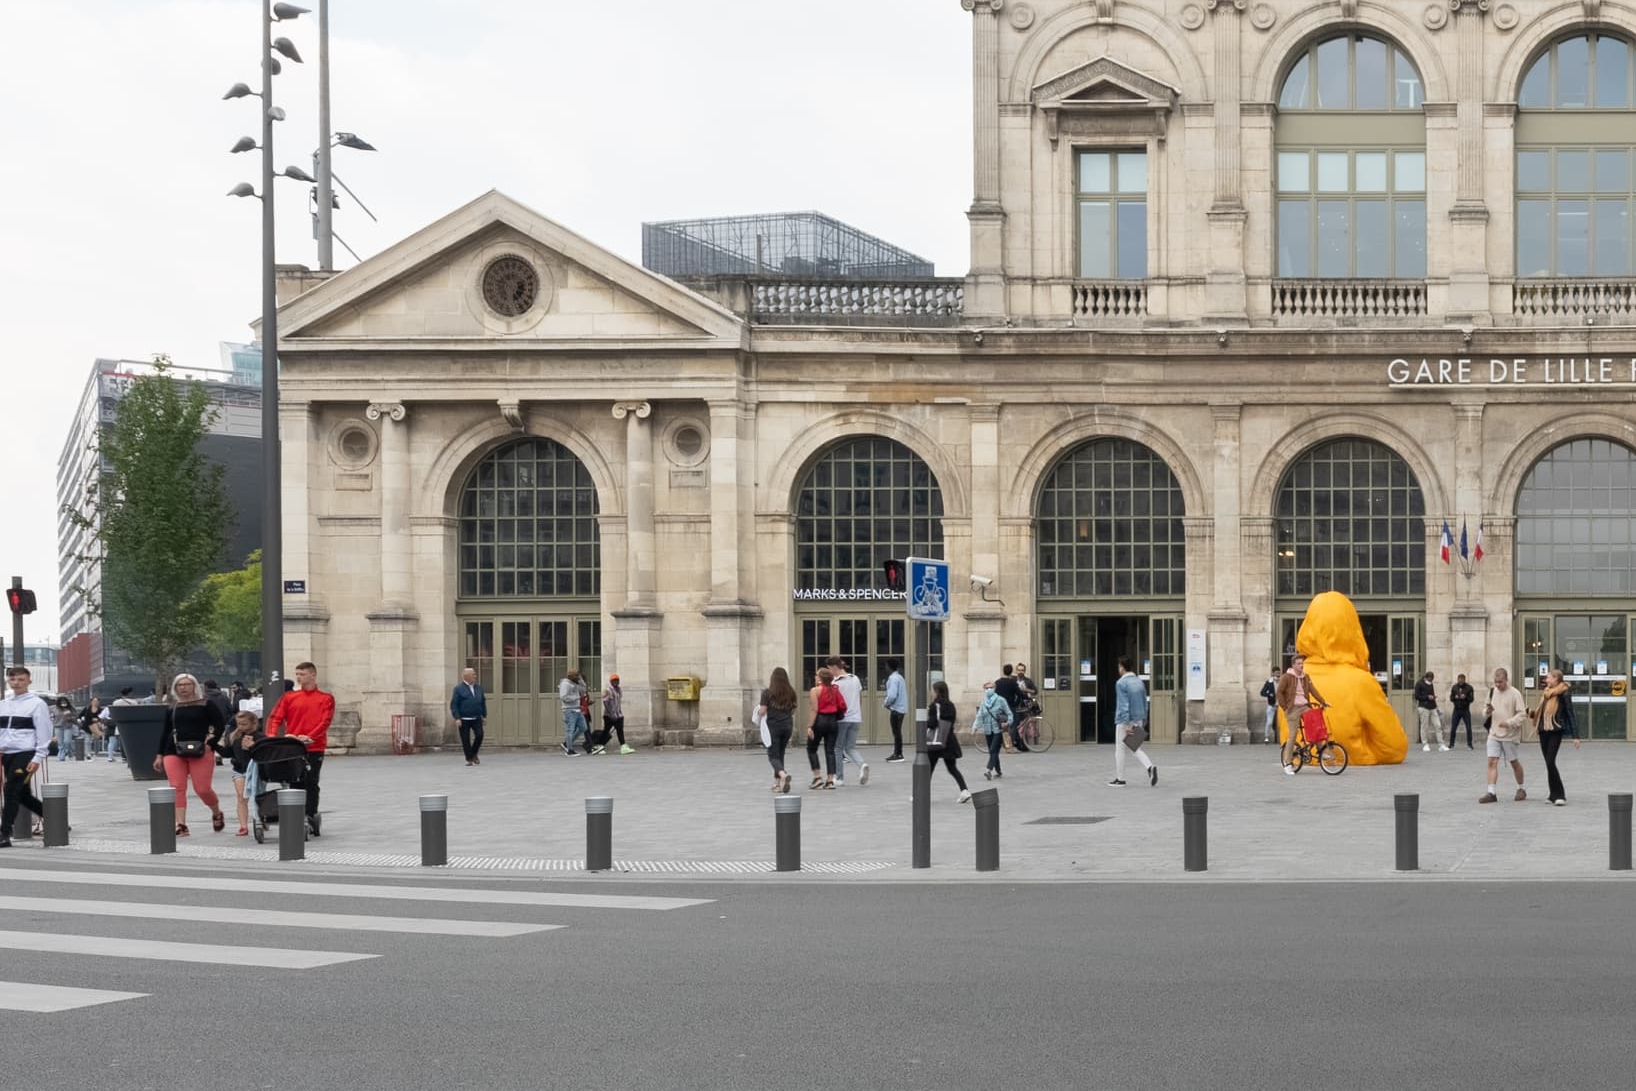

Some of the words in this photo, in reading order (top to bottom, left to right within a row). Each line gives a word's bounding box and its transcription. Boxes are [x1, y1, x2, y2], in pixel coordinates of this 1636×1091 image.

[1387, 358, 1471, 383] GARE
[1489, 359, 1526, 383] DE
[1544, 358, 1613, 383] LILLE
[793, 588, 836, 600] MARKS
[839, 588, 848, 600] &
[849, 588, 907, 600] SPENCER
